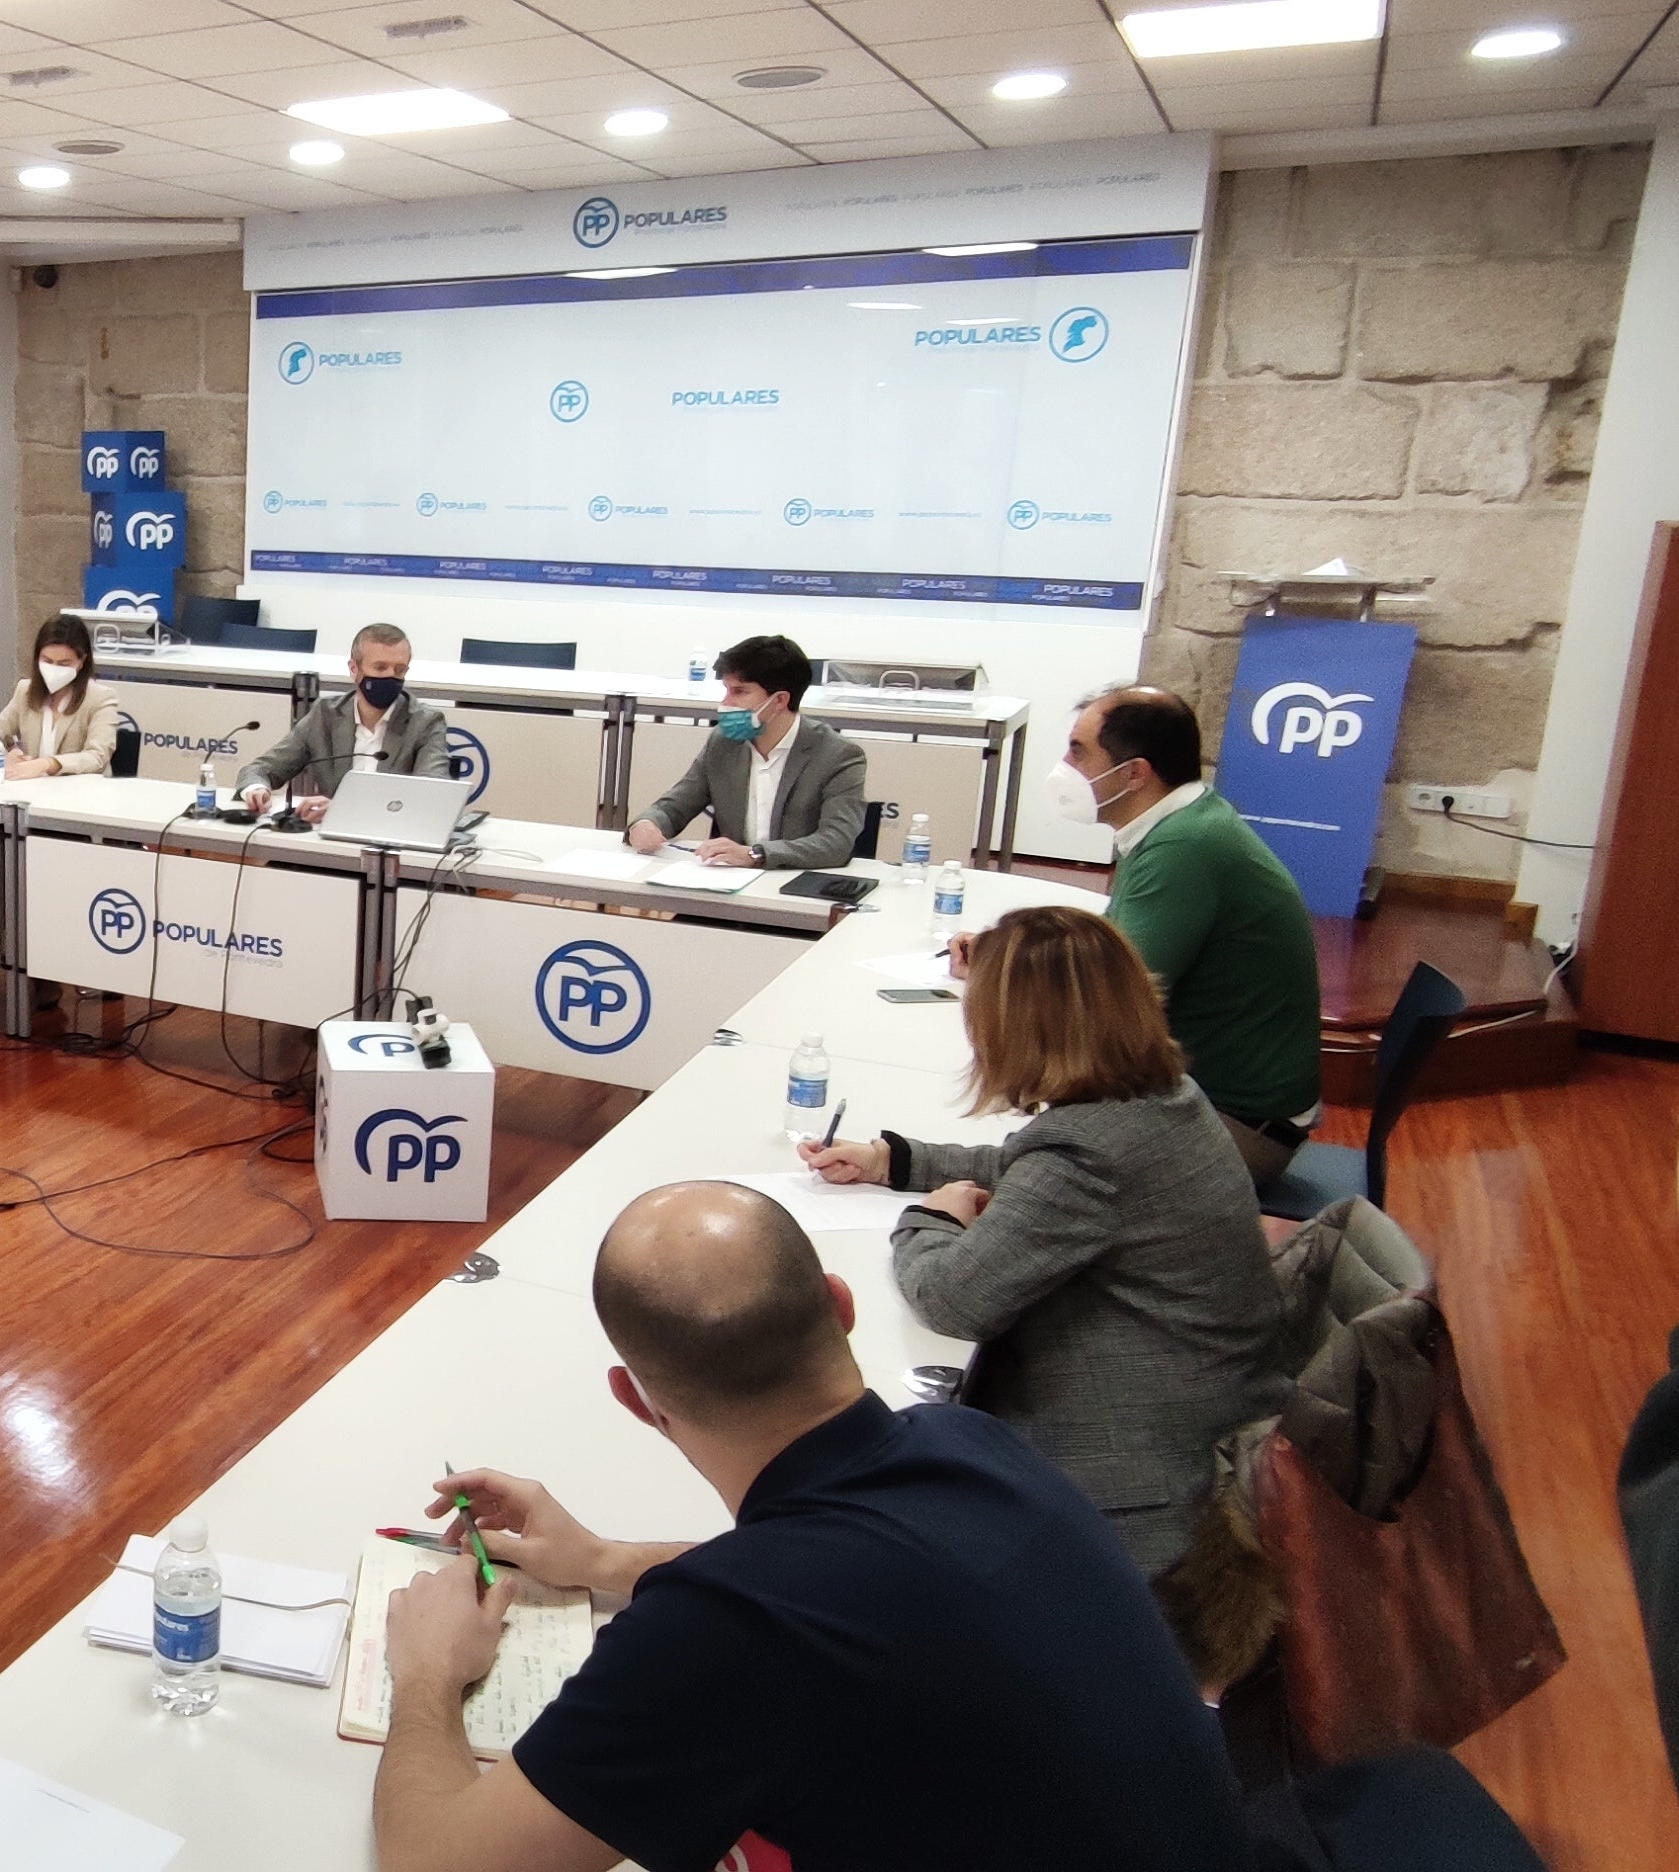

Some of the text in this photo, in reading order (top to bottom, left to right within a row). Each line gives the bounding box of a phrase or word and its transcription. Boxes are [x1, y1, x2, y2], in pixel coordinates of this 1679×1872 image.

[582, 213, 611, 237] PP
[623, 206, 728, 229] POPULARES
[914, 326, 1042, 346] POPULARES
[318, 351, 403, 367] POPULARES
[557, 394, 582, 413] PP
[671, 389, 780, 406] POPULARES
[812, 508, 875, 518] POPULARES
[1041, 511, 1113, 523] POPULARES
[772, 575, 832, 585] POPULARES
[901, 578, 967, 590] POPULARES
[1043, 584, 1114, 597] POPULARES
[143, 732, 239, 755] POPULARES
[100, 908, 284, 958] PP POPULARES
[558, 974, 629, 1027] PP
